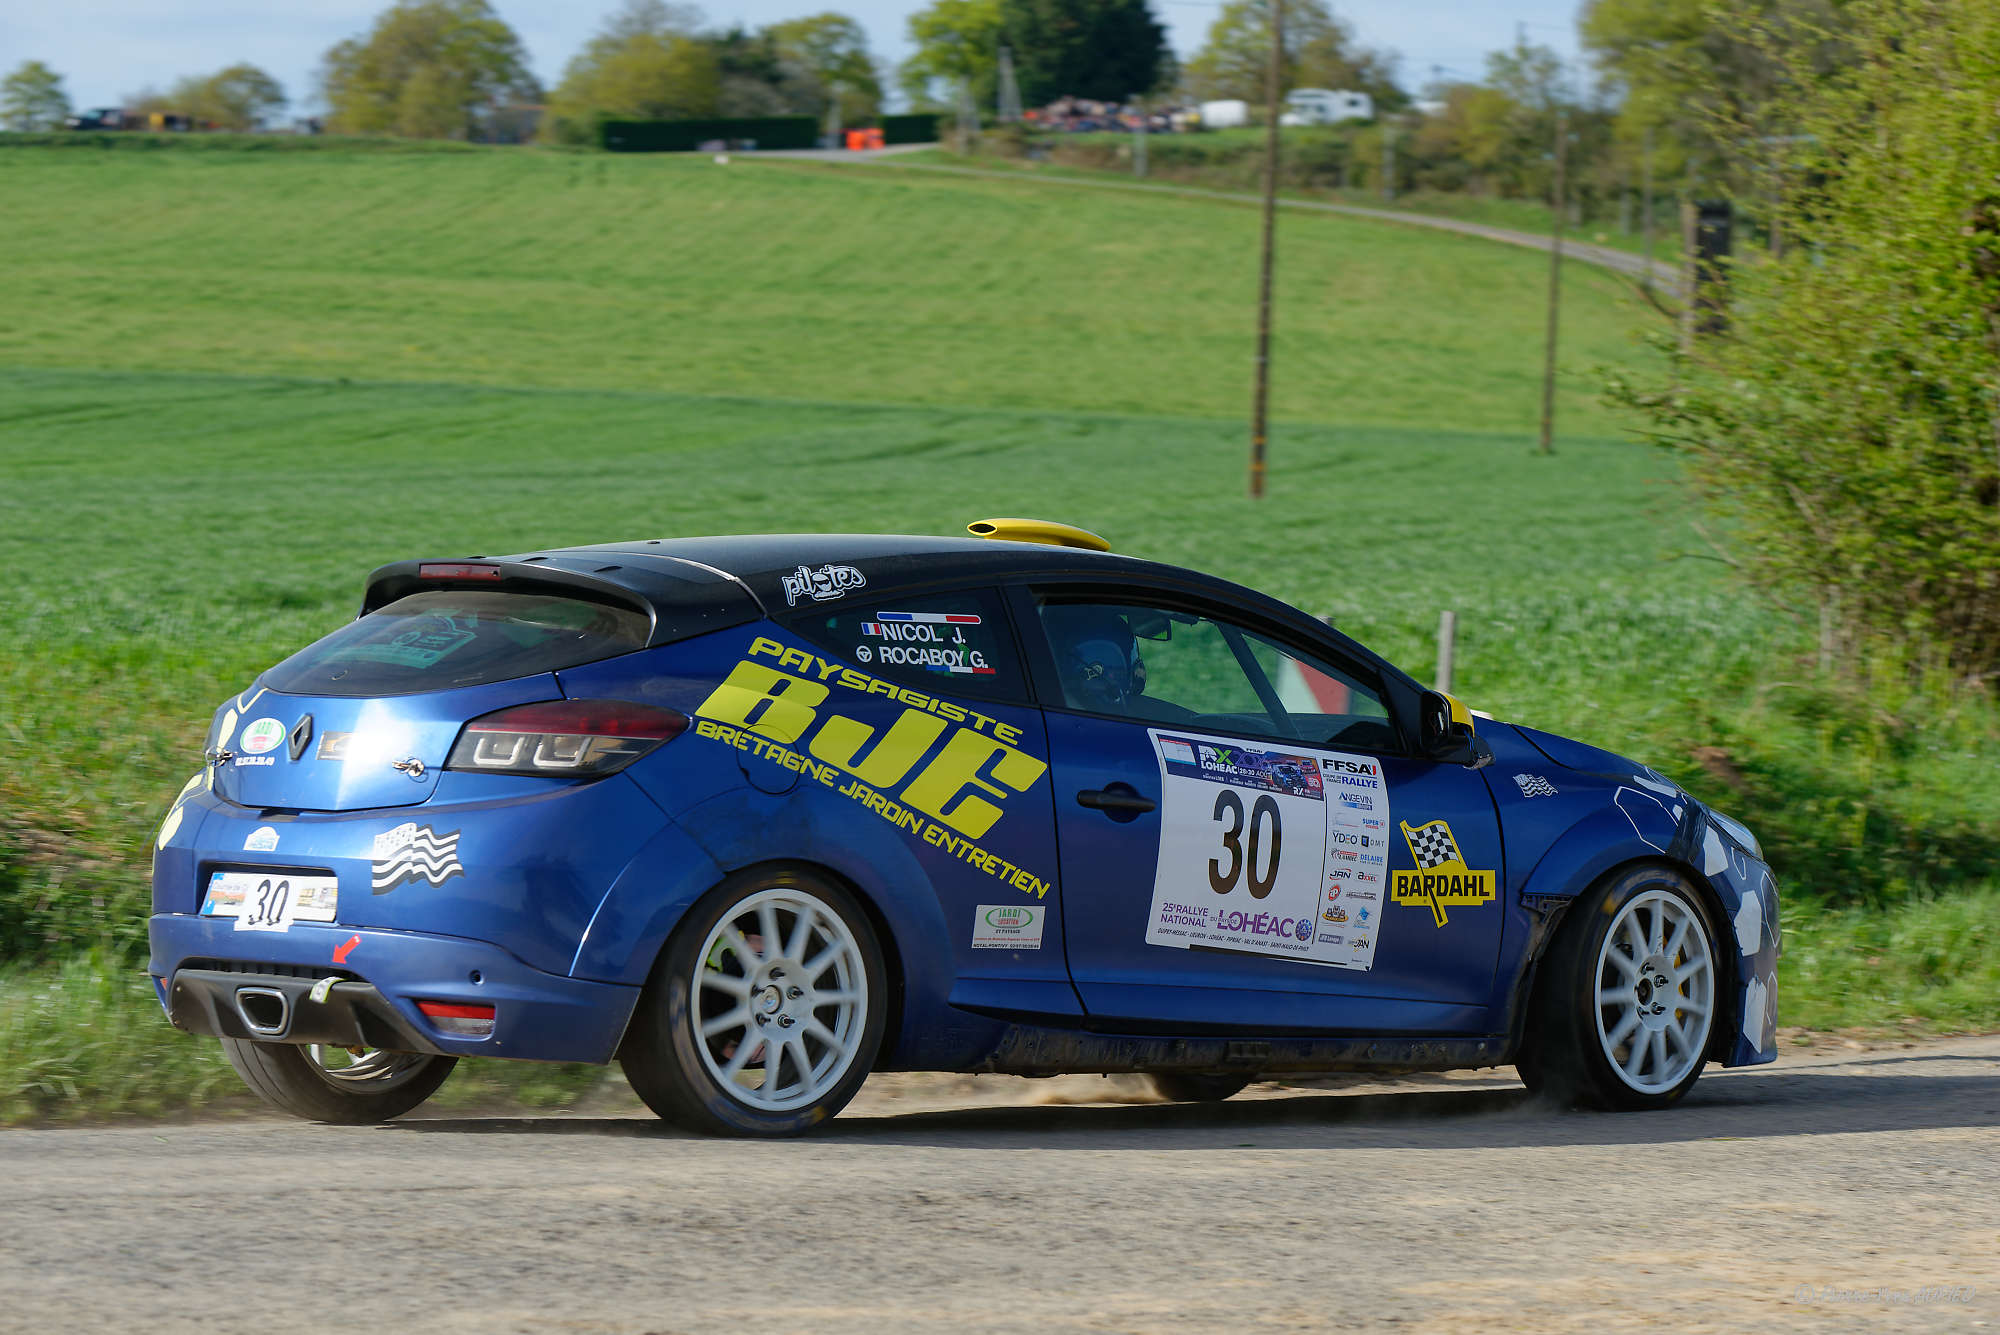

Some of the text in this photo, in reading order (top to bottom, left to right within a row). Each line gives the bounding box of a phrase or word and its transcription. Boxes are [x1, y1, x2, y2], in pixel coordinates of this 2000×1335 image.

[880, 623, 966, 644] NICOL J.
[879, 646, 989, 669] ROCABOY G.
[748, 637, 1024, 746] PAYSAGISTE
[695, 660, 1048, 840] BJE
[1201, 761, 1239, 775] LOHEAC
[1322, 759, 1374, 776] FFSA
[1342, 776, 1378, 789] RALLYE
[1338, 792, 1373, 805] ANGEVIN
[695, 720, 1051, 899] BRETAGNE JARDIN ENTRETIEN
[1362, 818, 1379, 826] SUPER
[1208, 789, 1282, 900] 30
[1333, 831, 1358, 845] YDEO
[1330, 871, 1351, 879] JAN
[1397, 875, 1490, 897] BARDAHL
[248, 879, 290, 926] 30
[1176, 904, 1208, 917] RALLYE
[1160, 914, 1207, 928] NATIONAL
[1217, 909, 1294, 938] LOHÉAC
